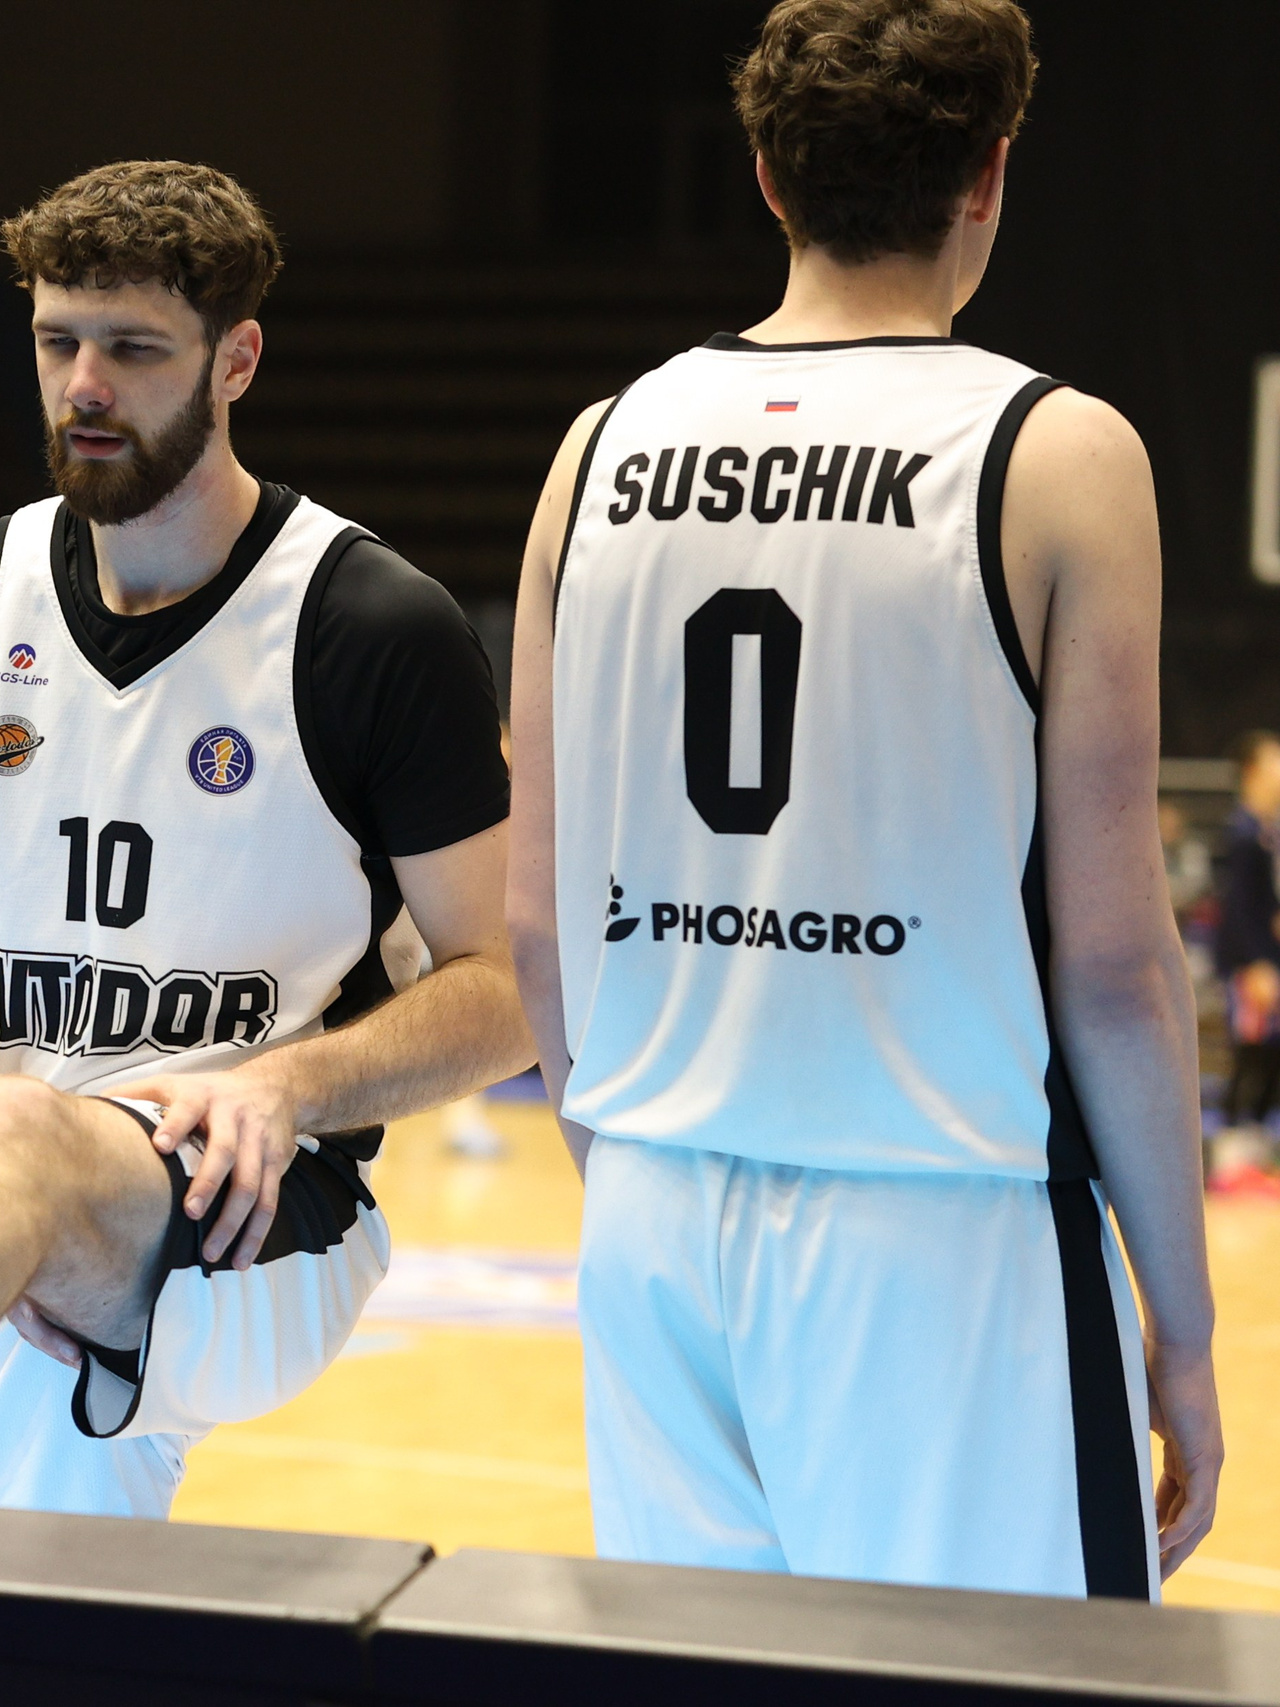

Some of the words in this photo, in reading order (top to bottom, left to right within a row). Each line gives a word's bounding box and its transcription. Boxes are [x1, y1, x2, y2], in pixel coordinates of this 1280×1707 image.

[608, 445, 933, 528] SUSCHIK
[684, 587, 802, 835] 0
[59, 817, 154, 929] 10
